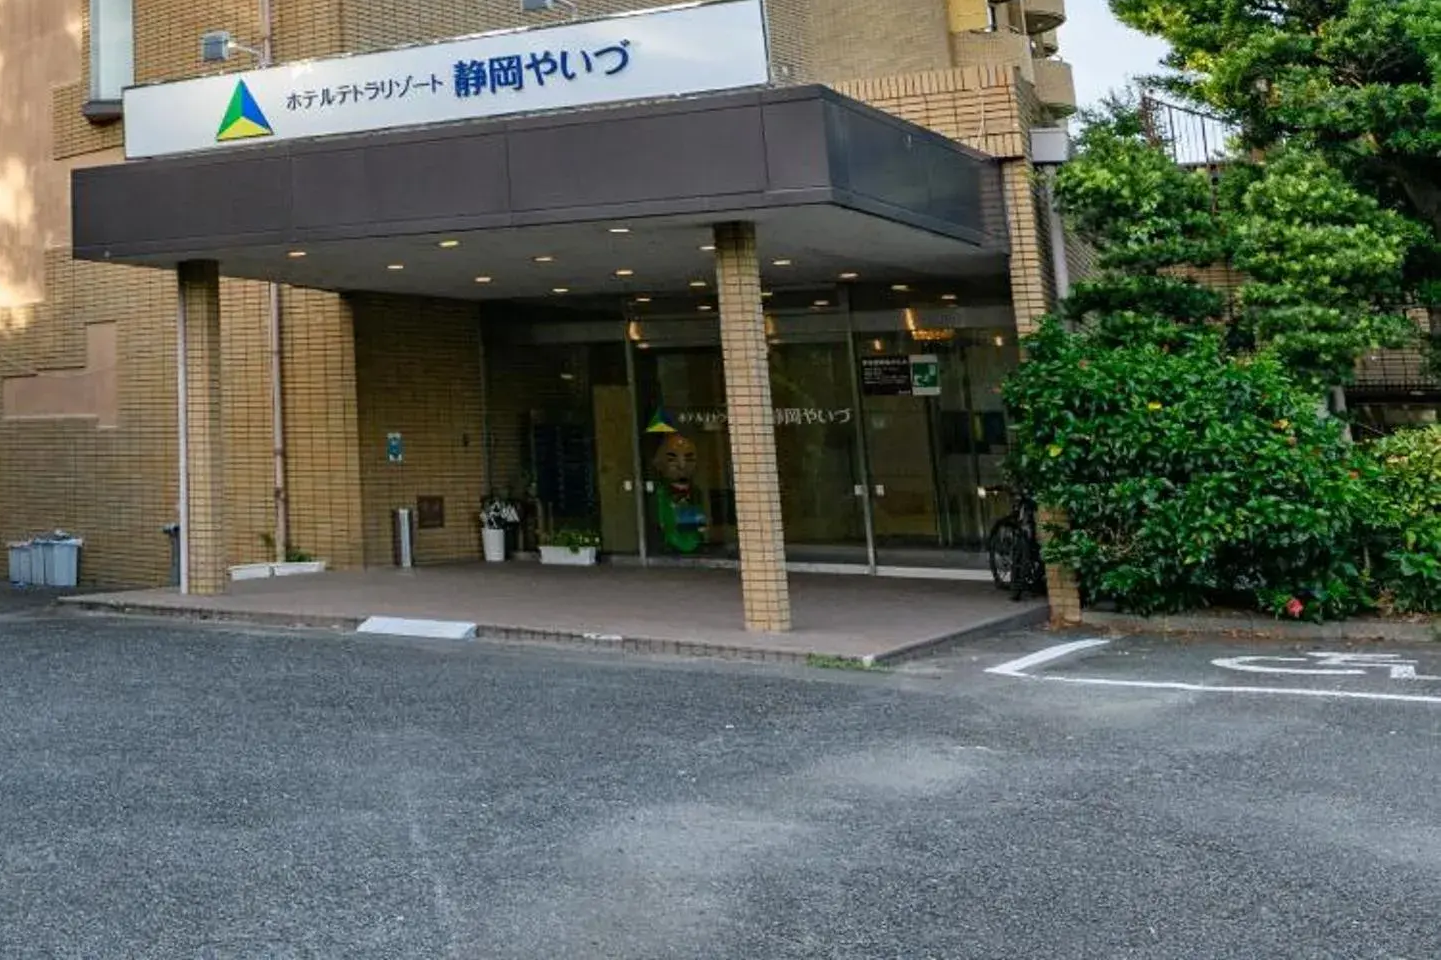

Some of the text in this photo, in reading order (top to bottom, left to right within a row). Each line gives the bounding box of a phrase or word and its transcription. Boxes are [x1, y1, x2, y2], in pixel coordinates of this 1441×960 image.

[286, 40, 631, 111] ホテルテトラリゾート 静岡やいづ
